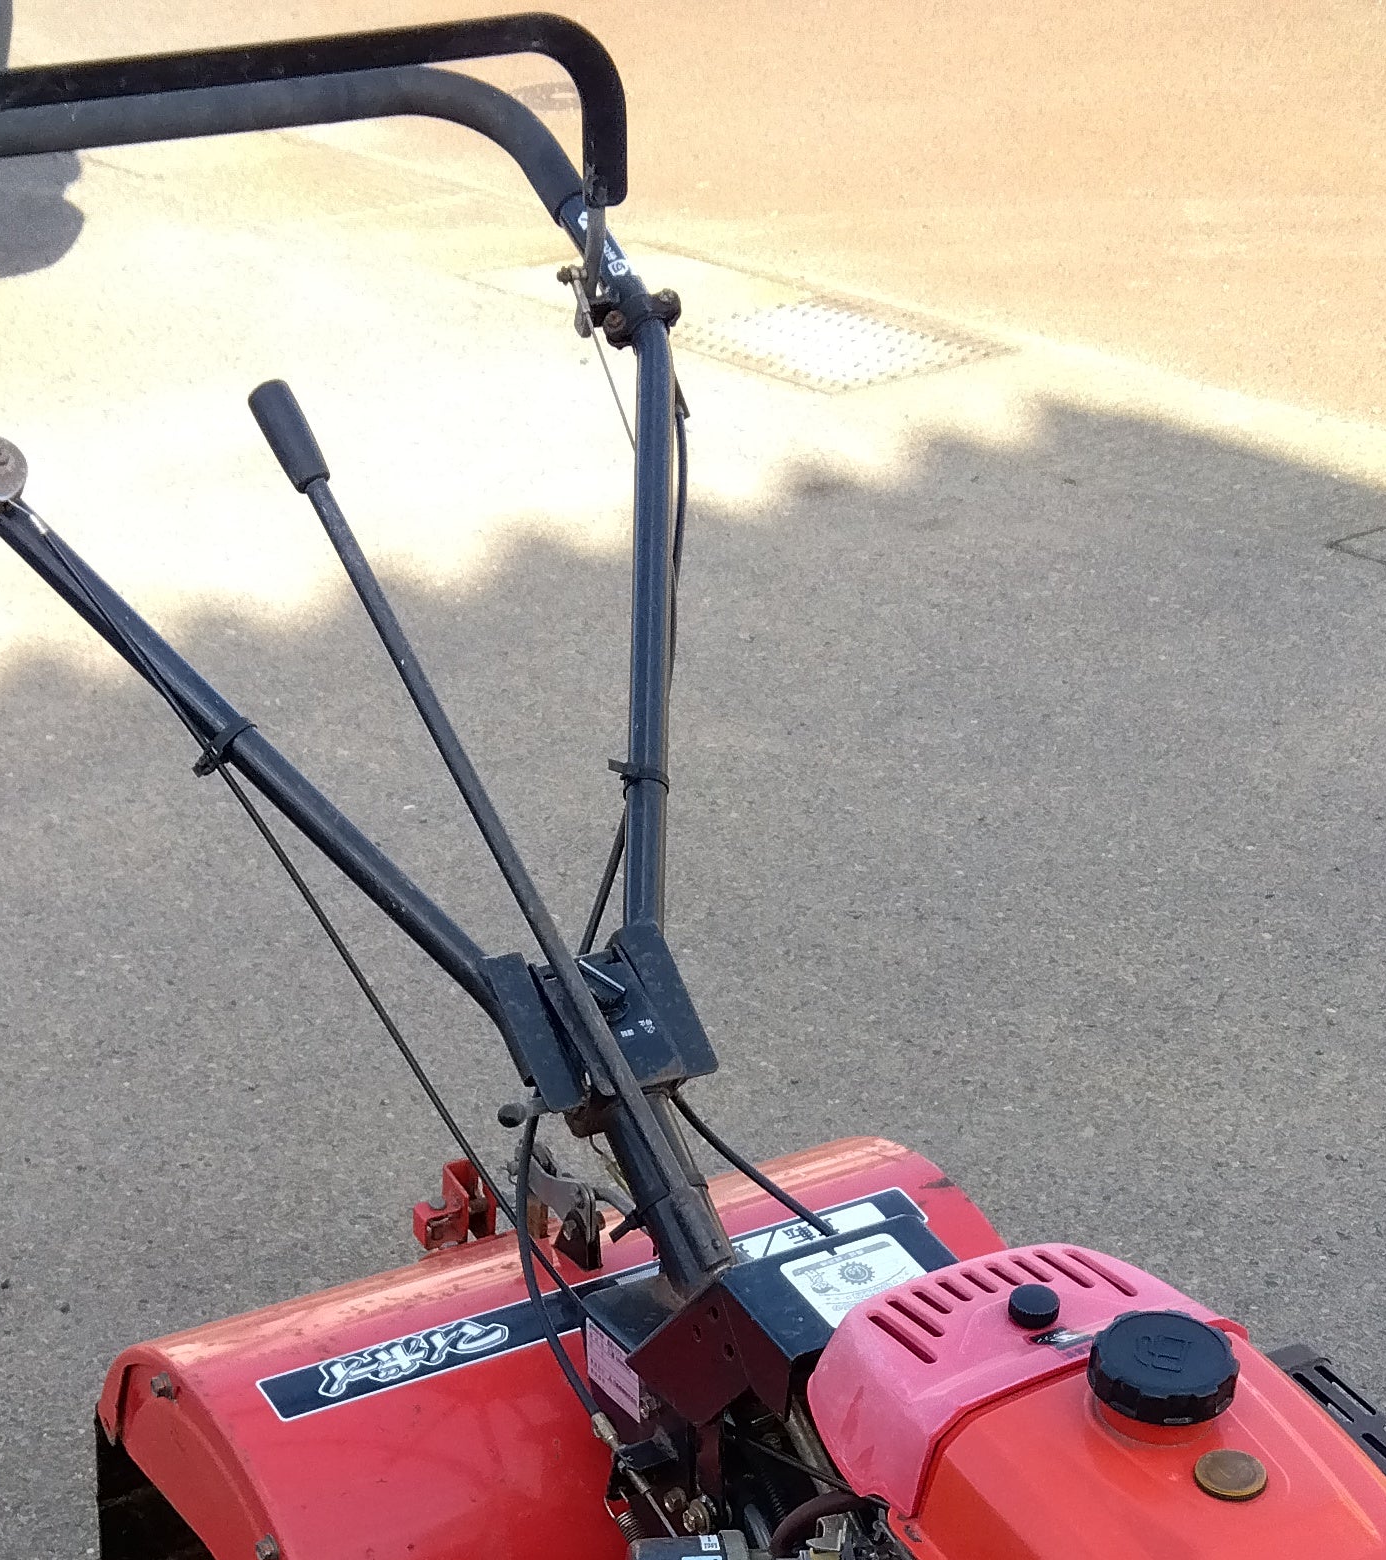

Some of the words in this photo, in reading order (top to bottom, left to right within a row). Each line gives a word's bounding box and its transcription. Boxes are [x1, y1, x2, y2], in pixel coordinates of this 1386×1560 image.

[319, 1321, 508, 1397] マイボーイ
